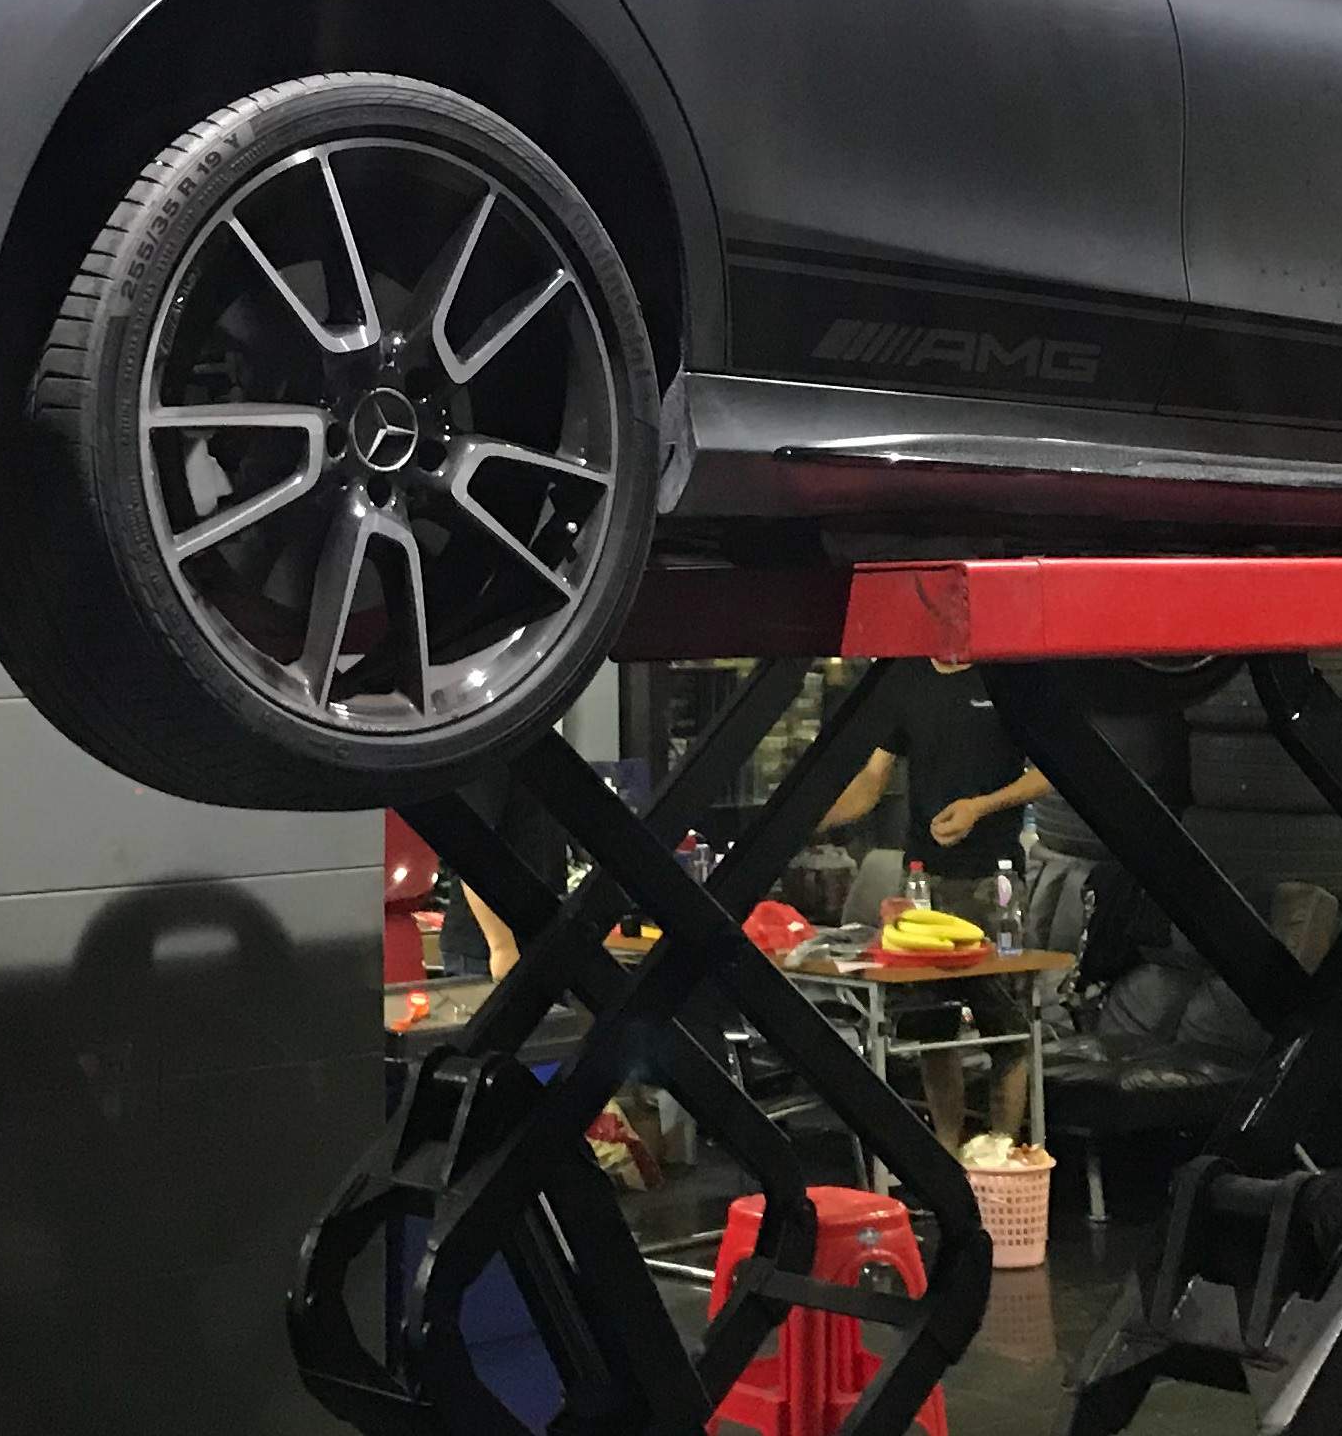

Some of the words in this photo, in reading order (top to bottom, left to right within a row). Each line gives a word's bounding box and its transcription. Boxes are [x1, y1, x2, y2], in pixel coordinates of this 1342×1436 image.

[120, 197, 180, 303] 255/35
[177, 176, 198, 197] R
[196, 150, 222, 176] 19
[905, 326, 1102, 384] AMG
